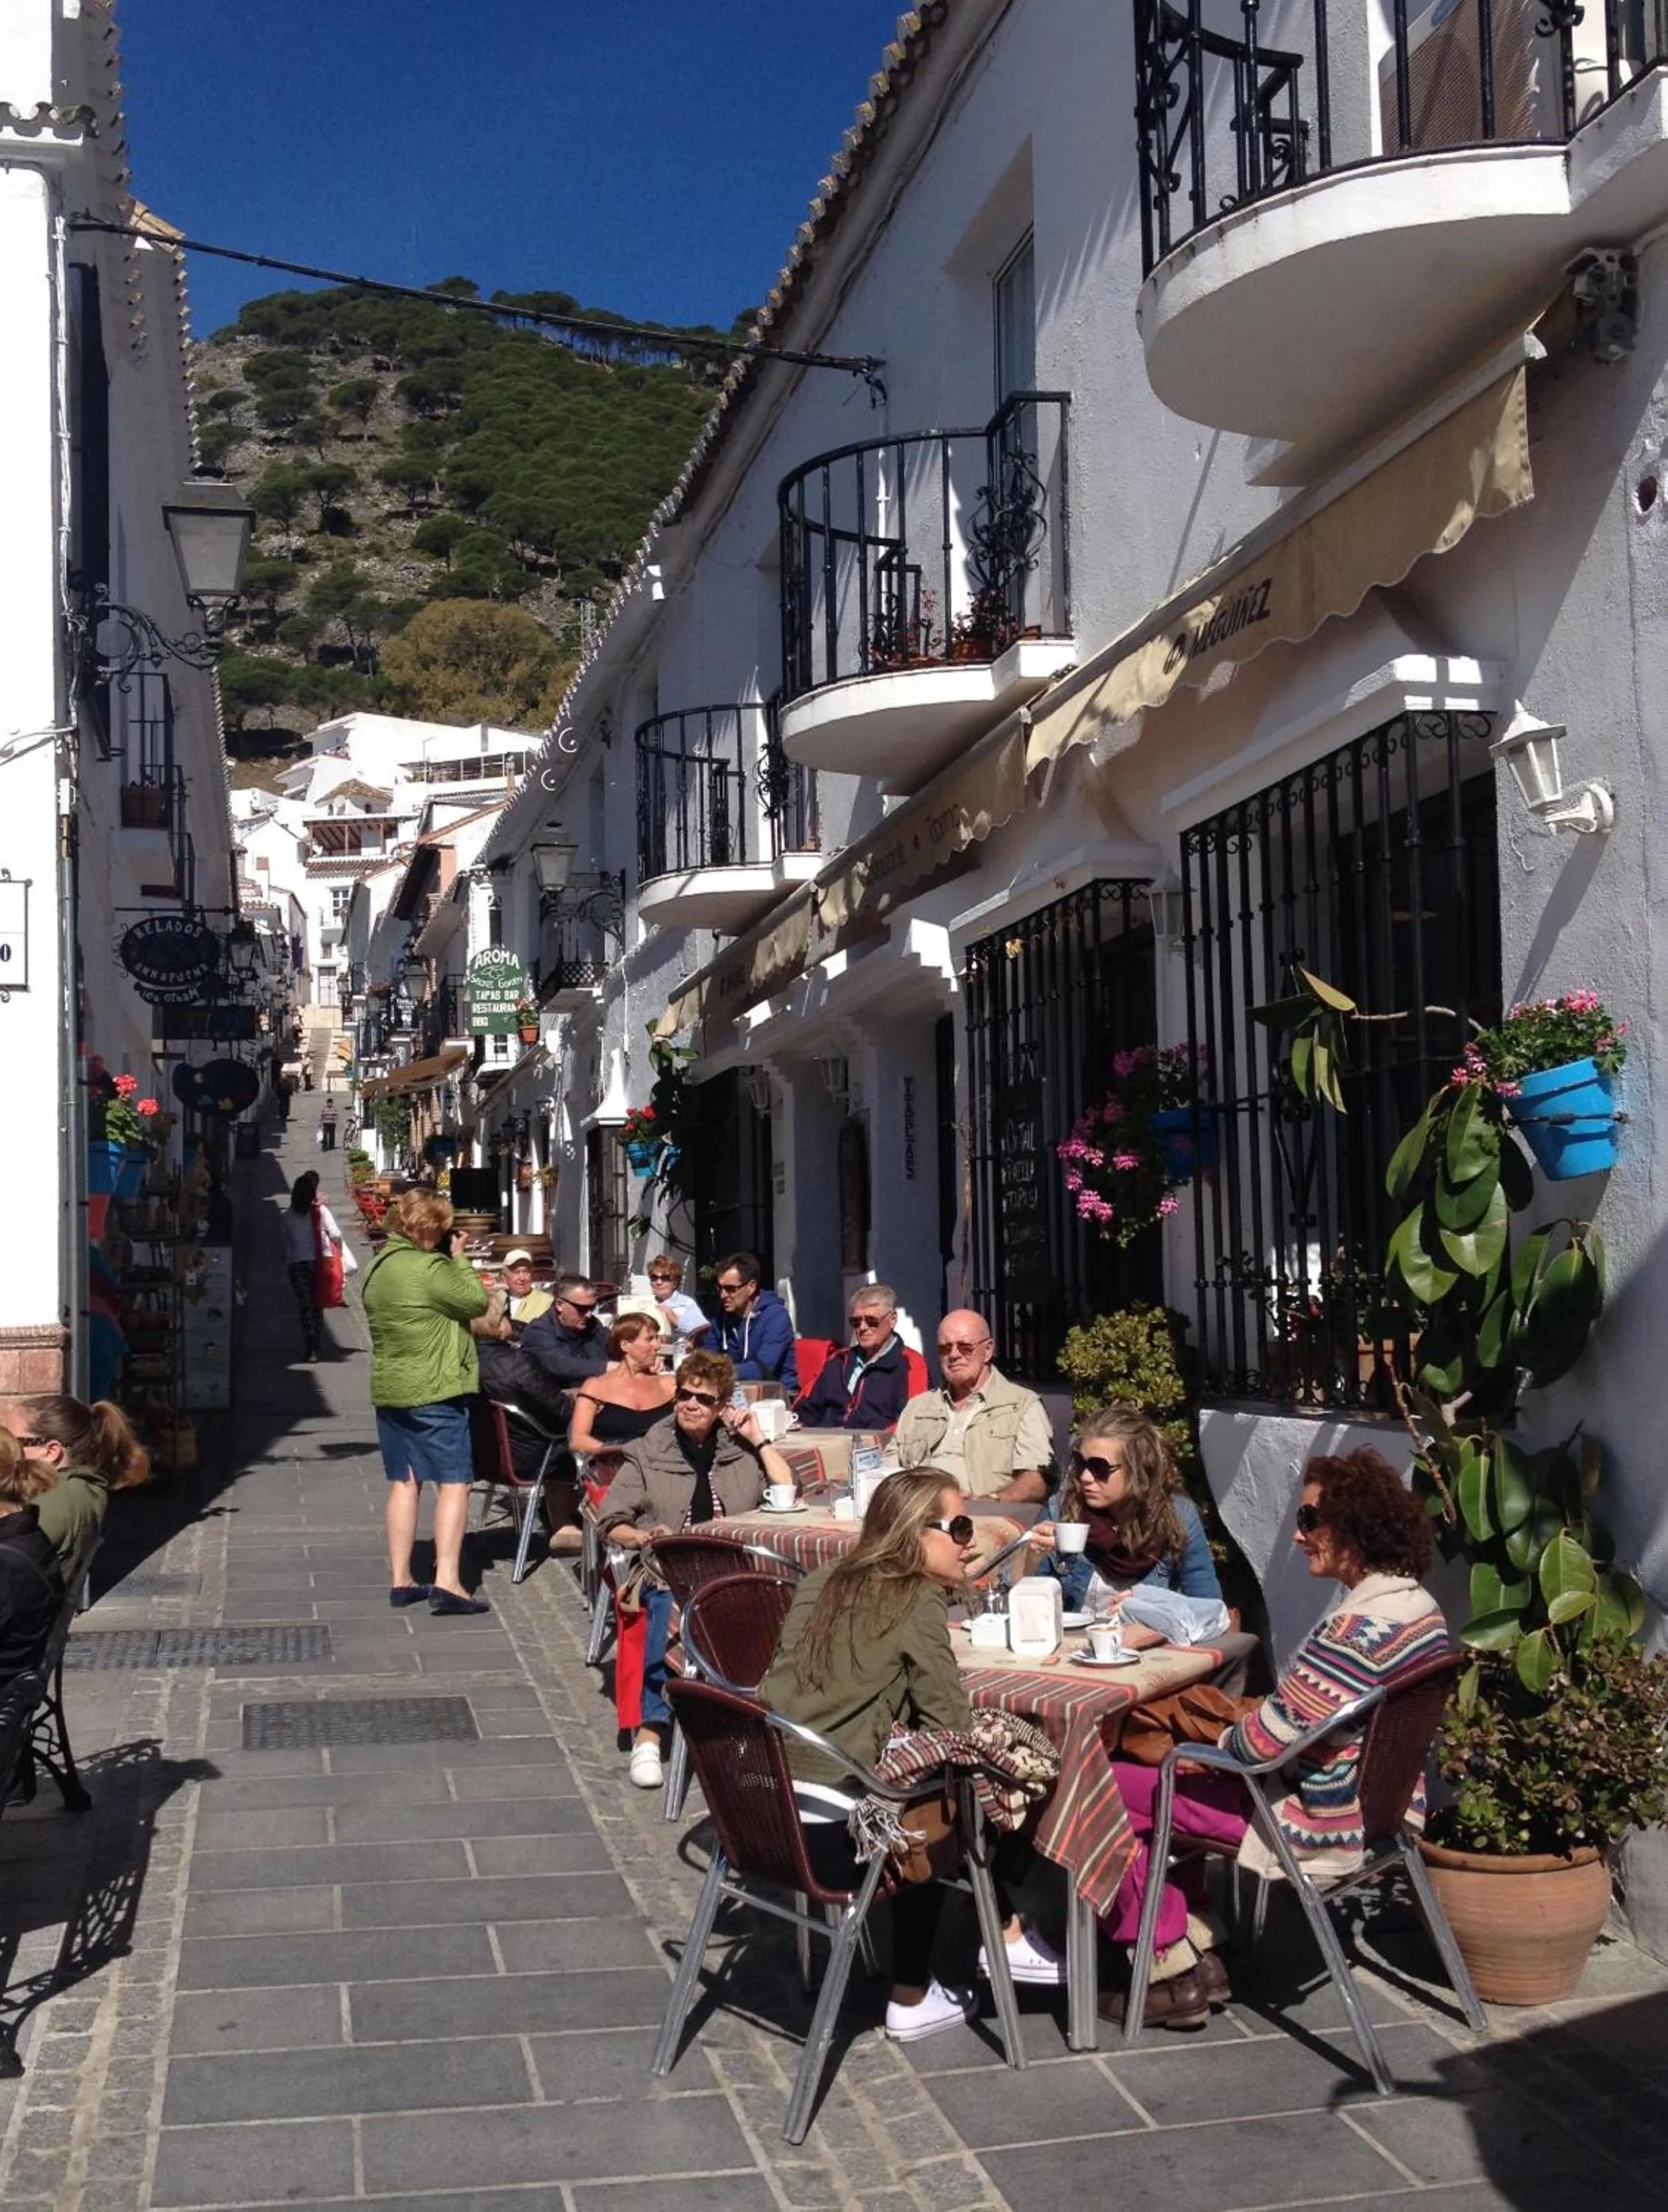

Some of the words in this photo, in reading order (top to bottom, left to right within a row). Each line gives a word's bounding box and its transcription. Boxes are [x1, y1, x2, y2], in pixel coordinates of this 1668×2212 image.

[133, 920, 203, 938] HELADOS
[474, 949, 520, 969] AROMA
[475, 991, 501, 1000] TAPAS
[504, 990, 520, 1000] BAR
[472, 1003, 521, 1013] RESTAURAN
[904, 1076, 915, 1181] TAPAS
